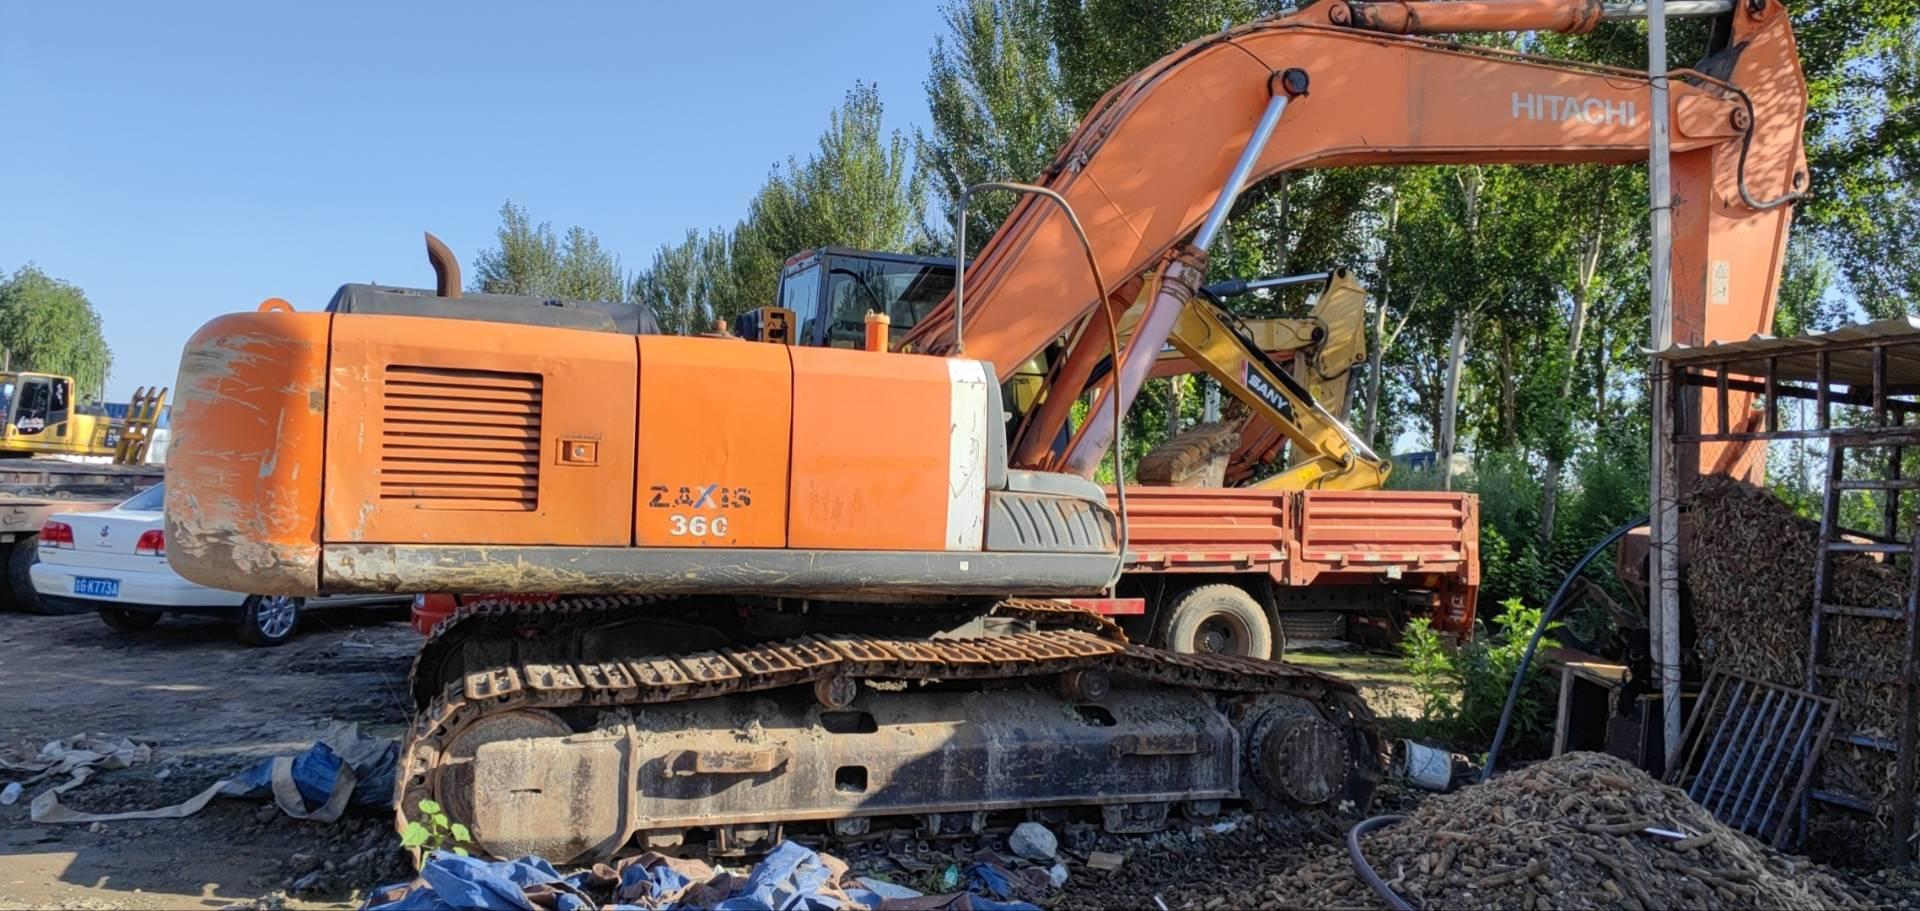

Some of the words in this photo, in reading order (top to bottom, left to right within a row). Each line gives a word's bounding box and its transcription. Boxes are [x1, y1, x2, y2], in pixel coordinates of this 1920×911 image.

[1511, 91, 1636, 127] HITACHI
[1248, 374, 1288, 409] SANY
[649, 484, 752, 509] ZAXIS
